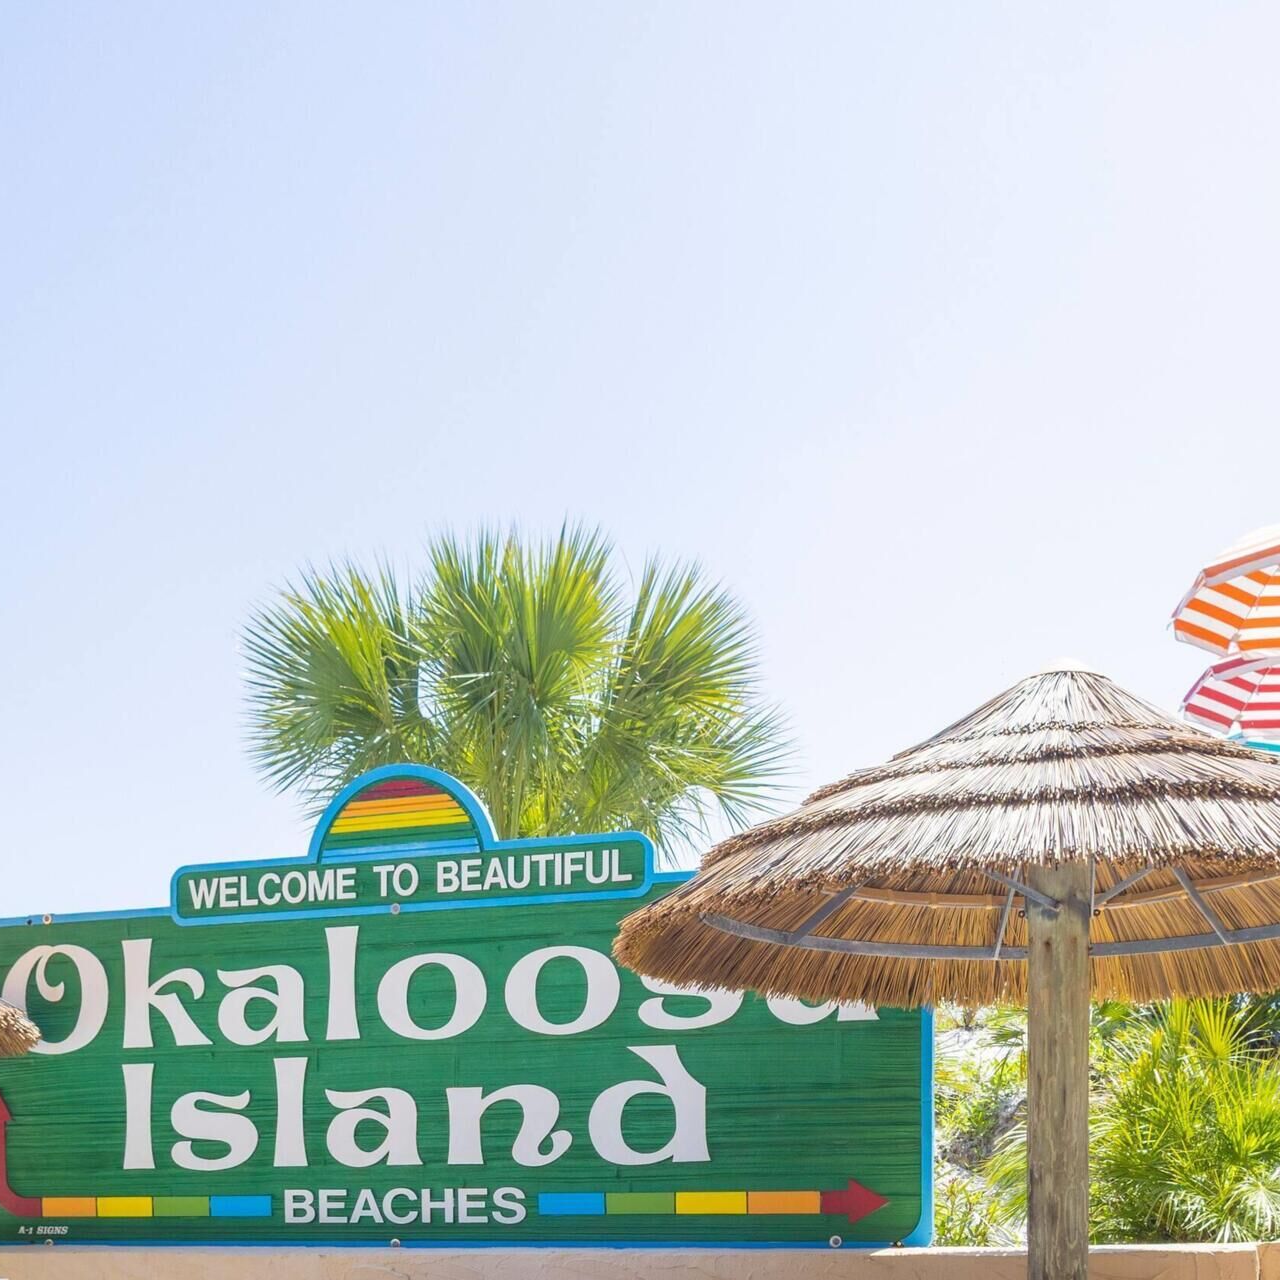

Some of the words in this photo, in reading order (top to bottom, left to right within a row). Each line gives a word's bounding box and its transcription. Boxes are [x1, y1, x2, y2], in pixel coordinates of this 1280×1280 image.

[188, 867, 357, 909] WELCOME
[373, 863, 418, 897] TO
[436, 848, 632, 894] BEAUTIFUL
[122, 1045, 711, 1171] Island
[17, 1225, 33, 1235] A-1
[36, 1225, 69, 1235] SIGNS
[284, 1186, 527, 1225] BEACHES
